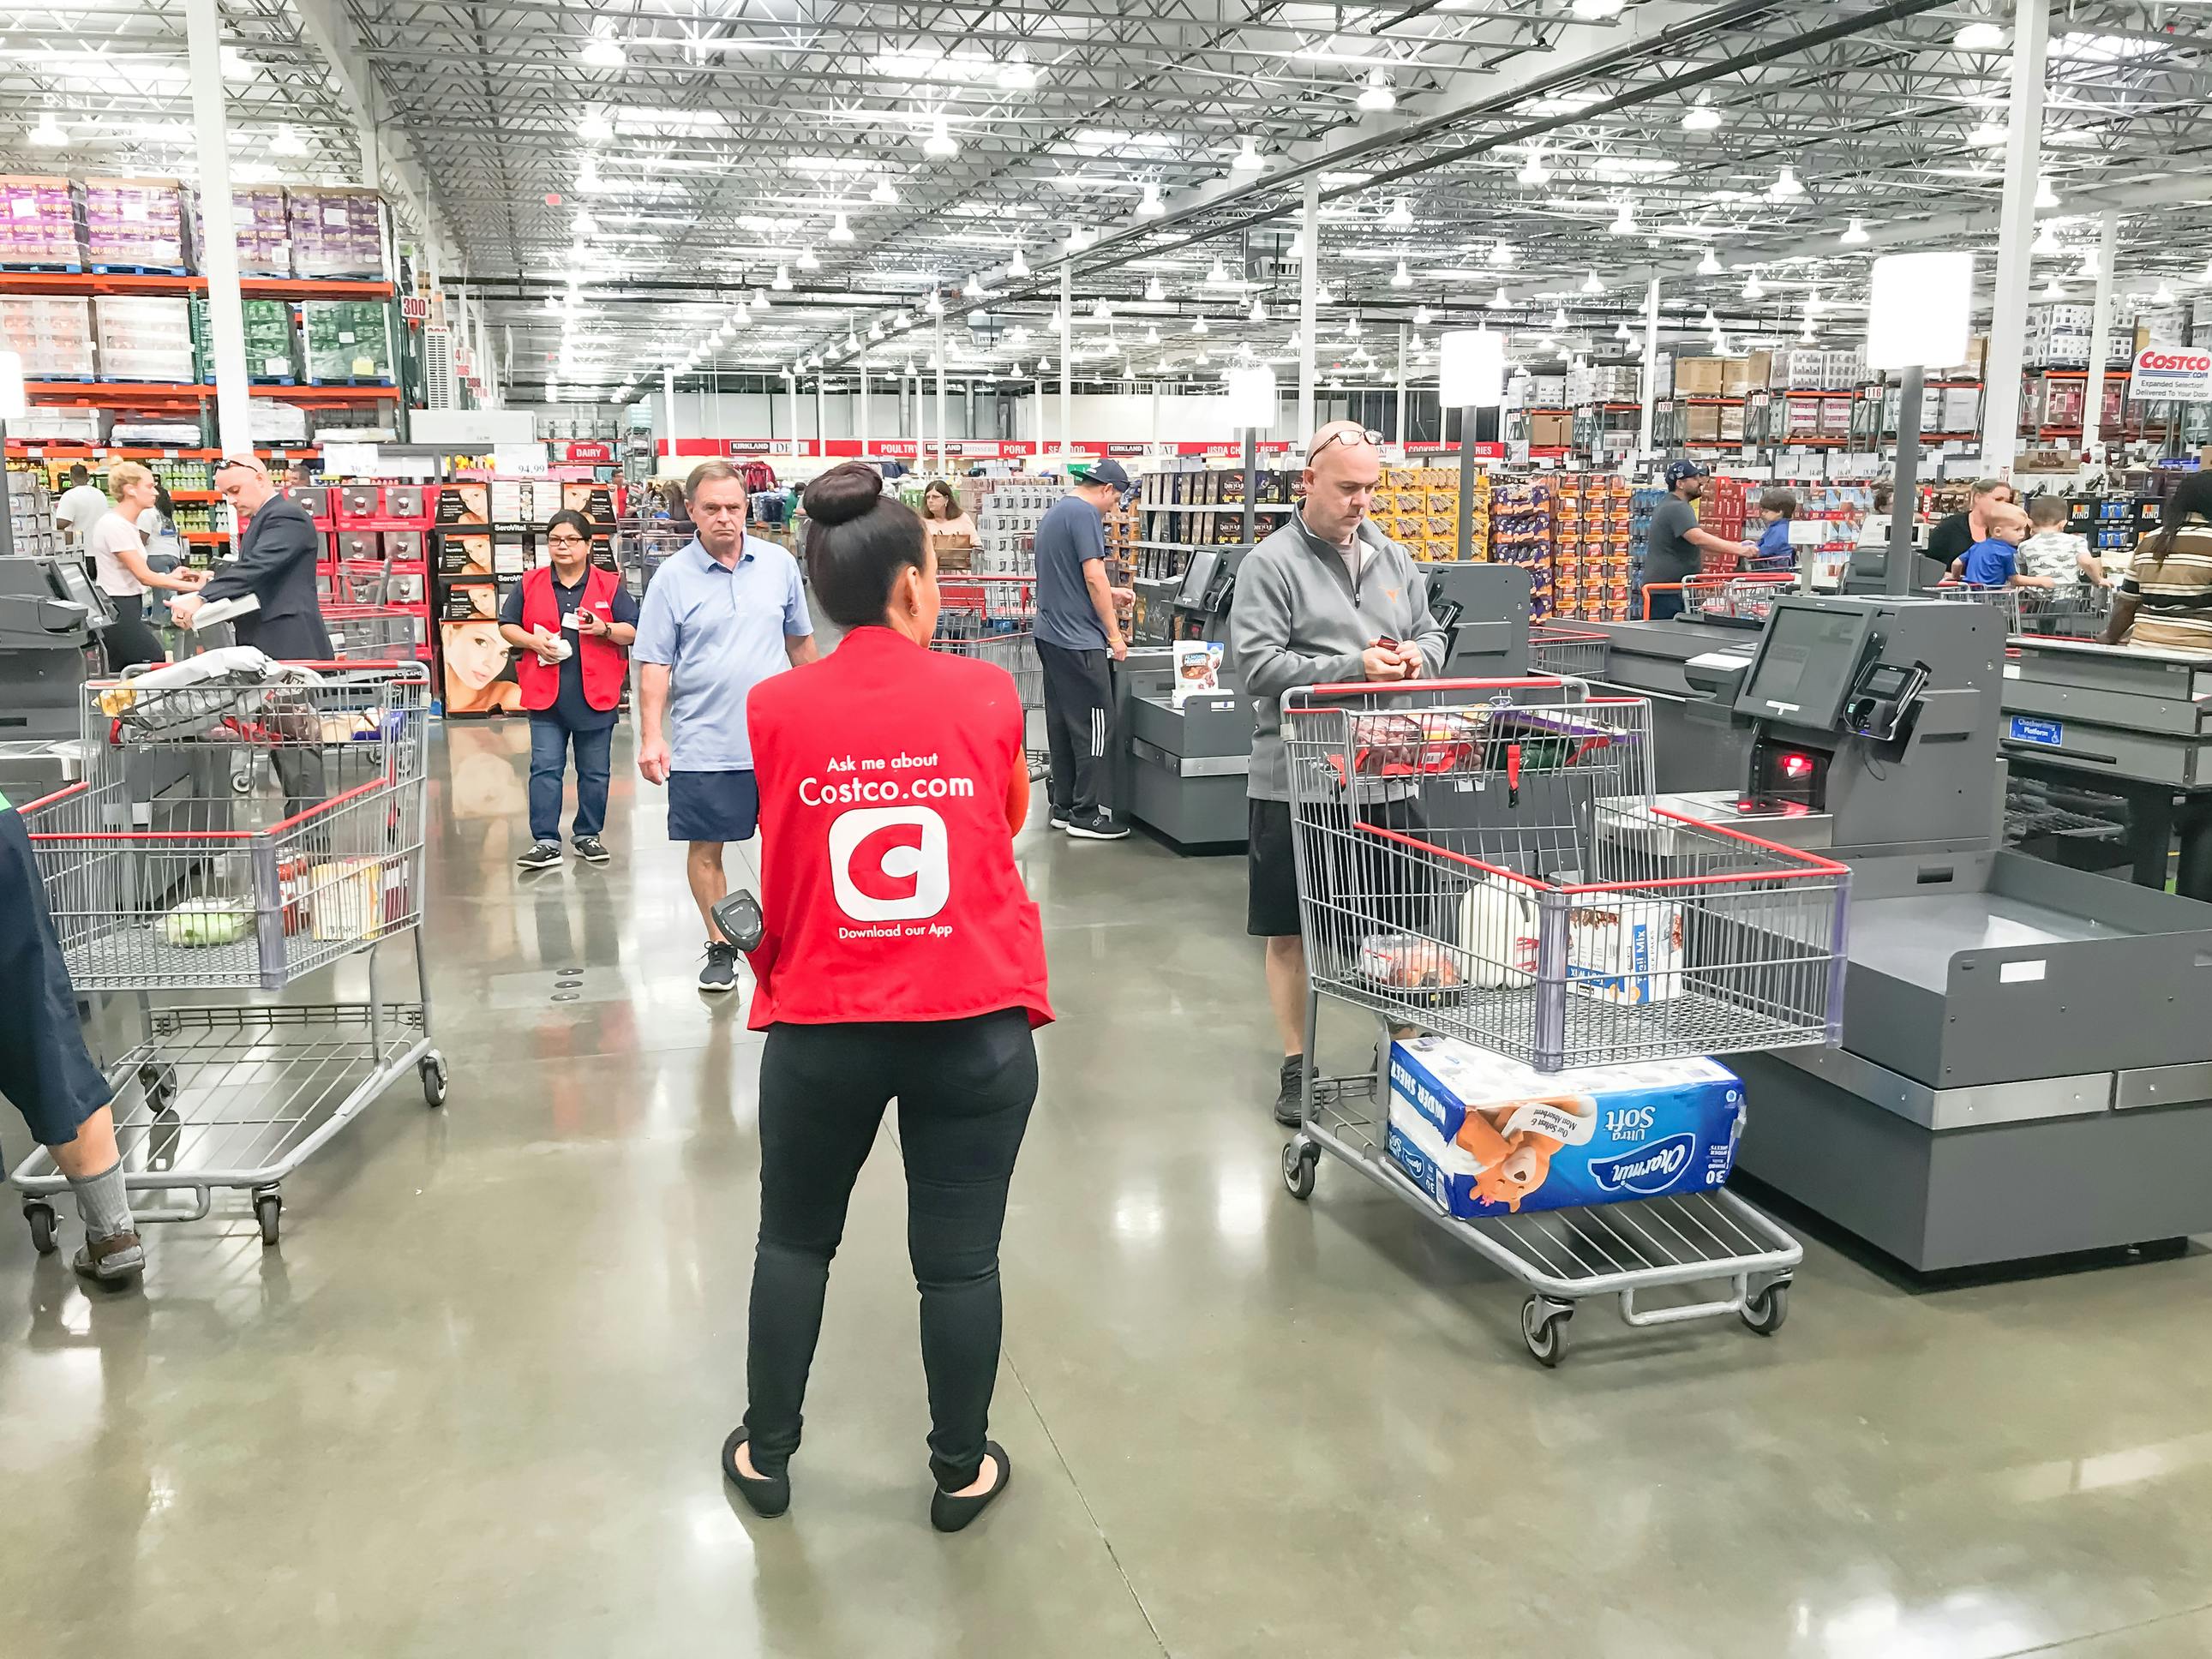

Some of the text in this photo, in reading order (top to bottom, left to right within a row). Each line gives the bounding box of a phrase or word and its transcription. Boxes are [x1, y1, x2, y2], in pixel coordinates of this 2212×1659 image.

[403, 297, 426, 316] 300
[2139, 351, 2210, 370] COSTCO
[2141, 380, 2173, 388] Expanded
[1867, 387, 1881, 398] 116
[2136, 388, 2167, 397] Delivered
[1753, 396, 1767, 404] 118
[575, 447, 602, 458] DAIRY
[880, 444, 918, 453] POULTRY
[1003, 445, 1027, 454] PORK
[1207, 446, 1228, 454] USDA
[518, 464, 545, 473] 94.99
[826, 752, 938, 772] Ask me about
[798, 776, 974, 806] Costco.com
[838, 923, 953, 939] Download our App
[1636, 930, 1646, 985] Tail Mix
[1562, 1117, 1578, 1130] Most
[1606, 1105, 1657, 1132] Soft
[1538, 1118, 1558, 1133] Softest
[1558, 1127, 1568, 1138] Our
[1612, 1127, 1646, 1141] Ultra
[1612, 1144, 1686, 1186] Charmin
[1705, 1170, 1726, 1184] 30
